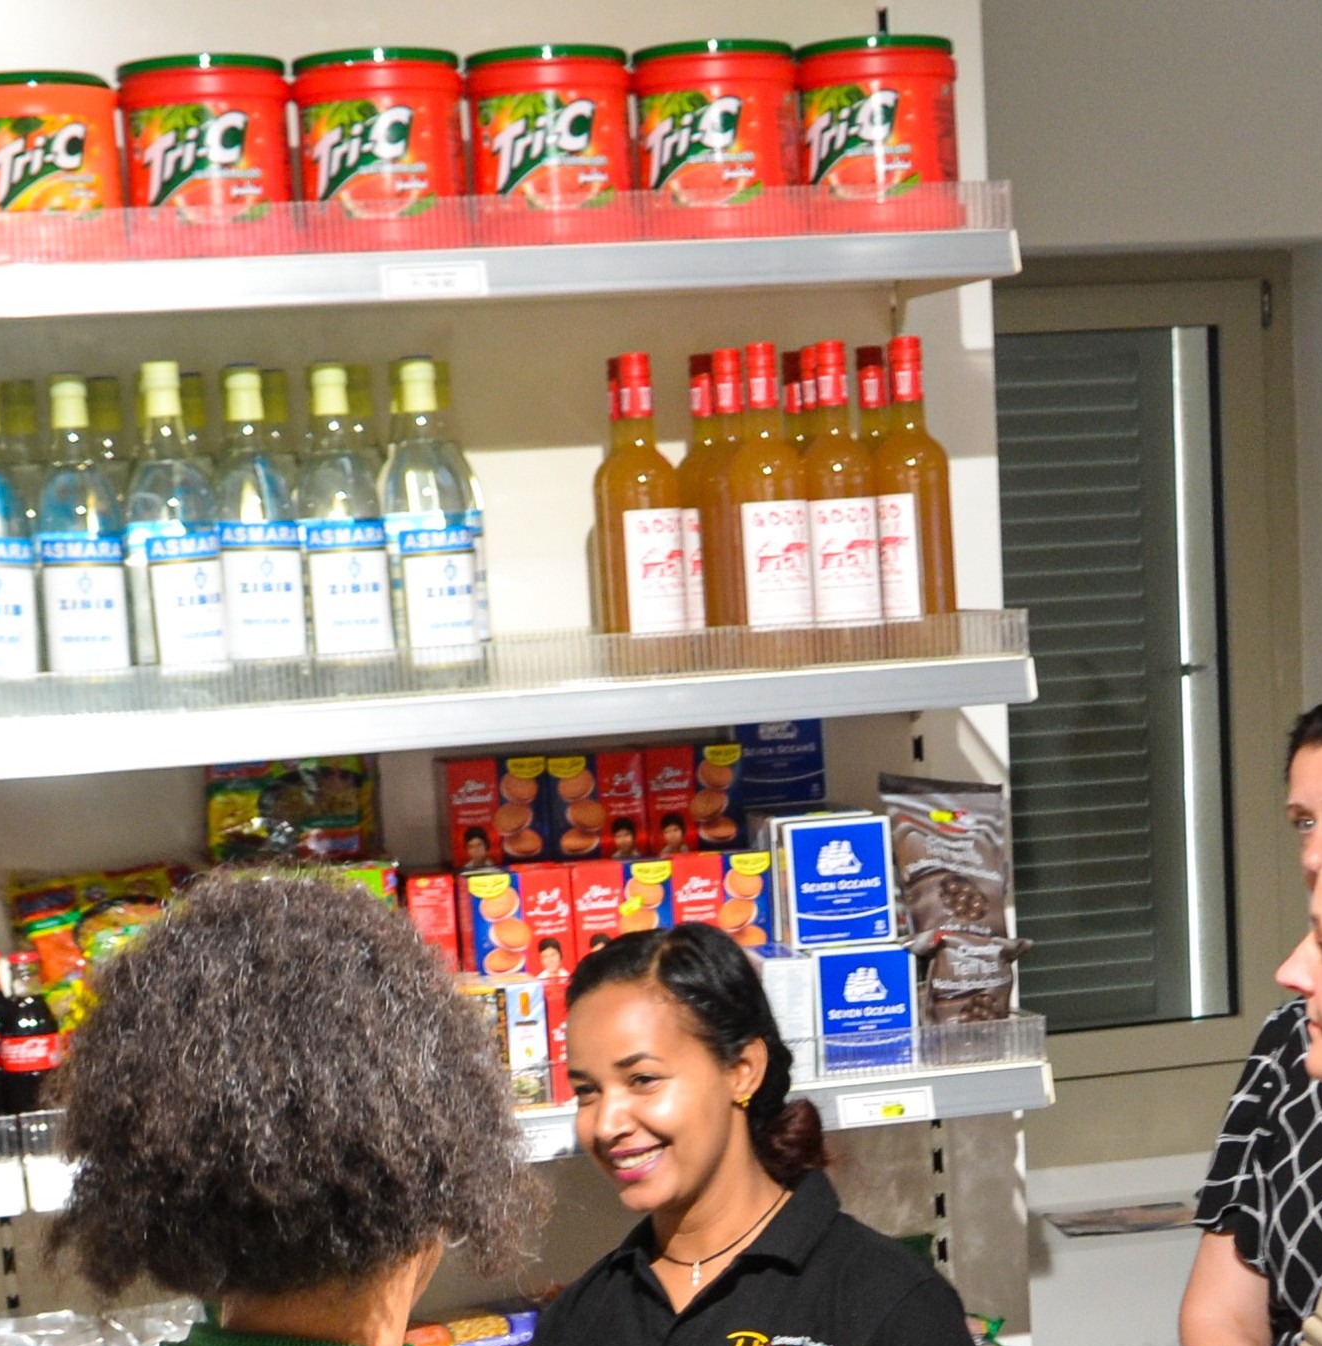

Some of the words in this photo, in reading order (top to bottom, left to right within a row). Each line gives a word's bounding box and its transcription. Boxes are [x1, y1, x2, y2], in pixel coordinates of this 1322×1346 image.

[143, 110, 249, 207] Tri-C
[313, 105, 413, 201] Tri-C
[492, 100, 596, 195] Tri-C
[646, 96, 742, 190] Tri-C
